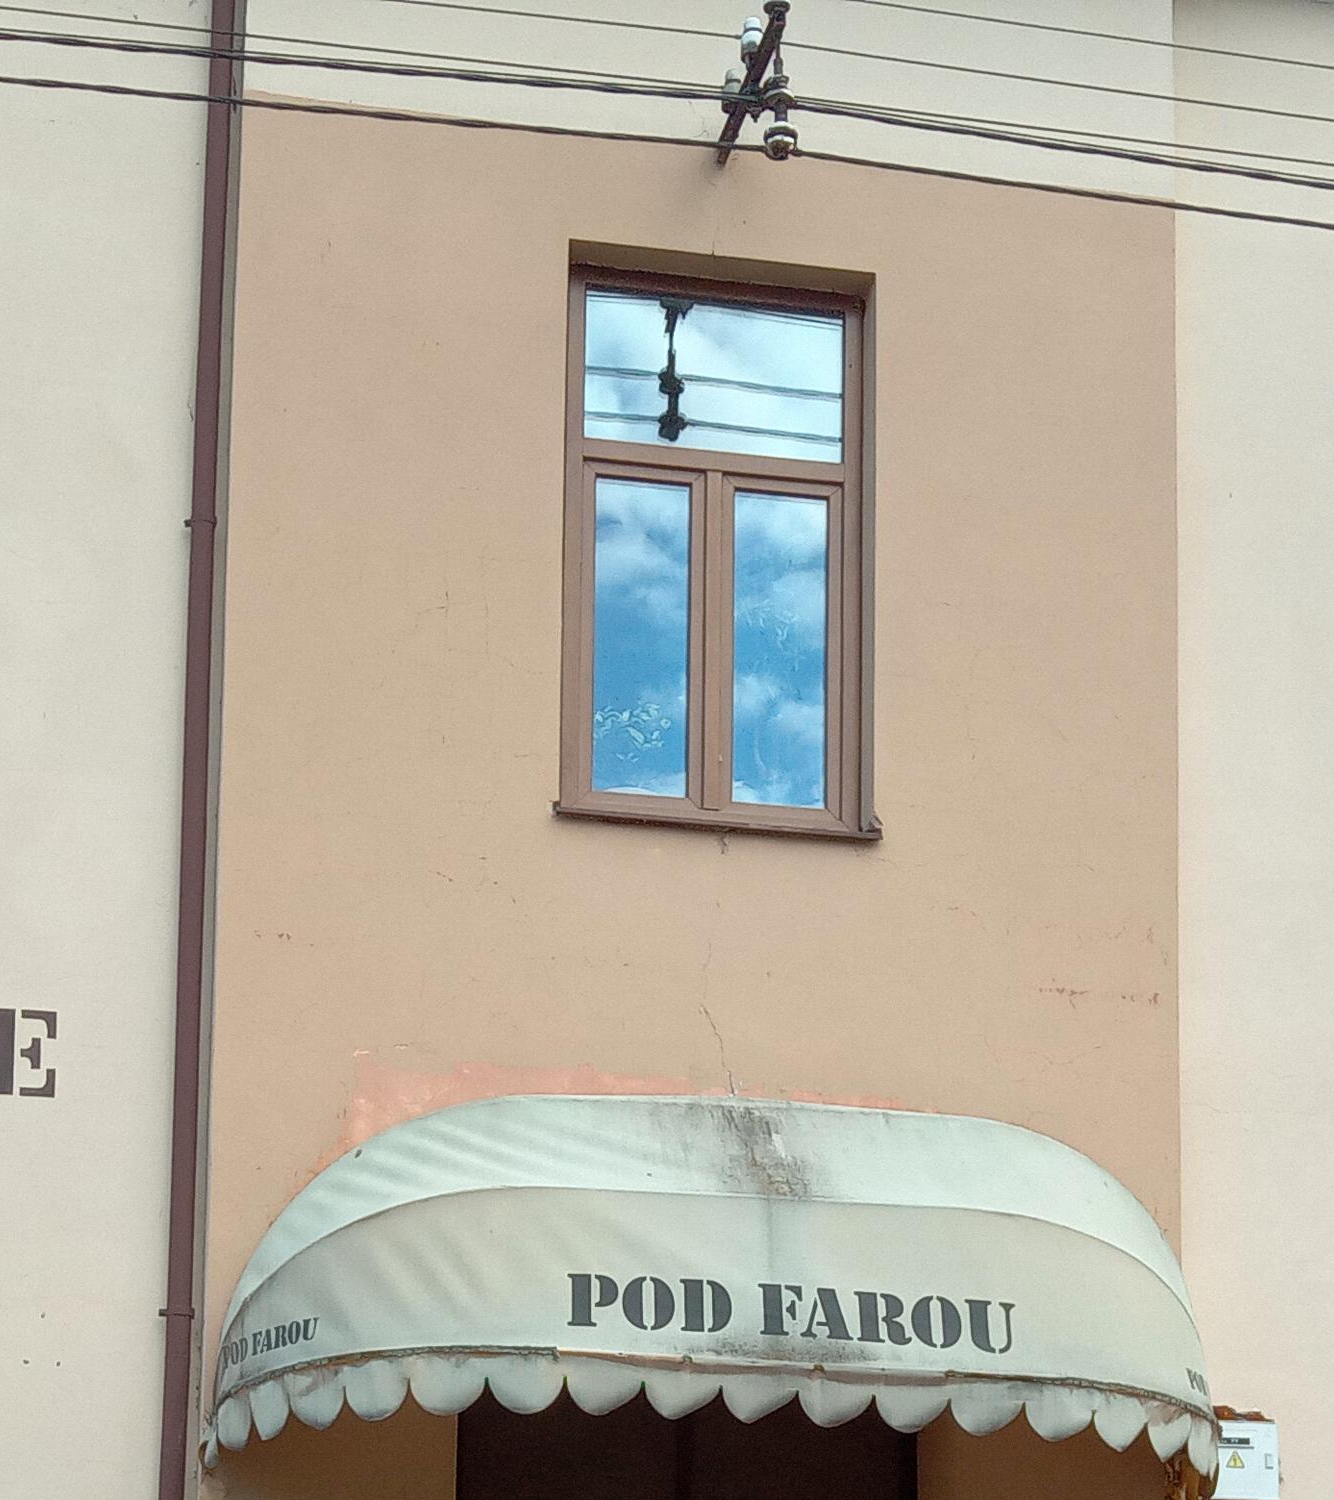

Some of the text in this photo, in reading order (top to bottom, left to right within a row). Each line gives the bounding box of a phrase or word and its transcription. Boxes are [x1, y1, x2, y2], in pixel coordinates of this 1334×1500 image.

[222, 1316, 320, 1369] POD FAROU
[566, 1272, 1017, 1356] POD FAROU
